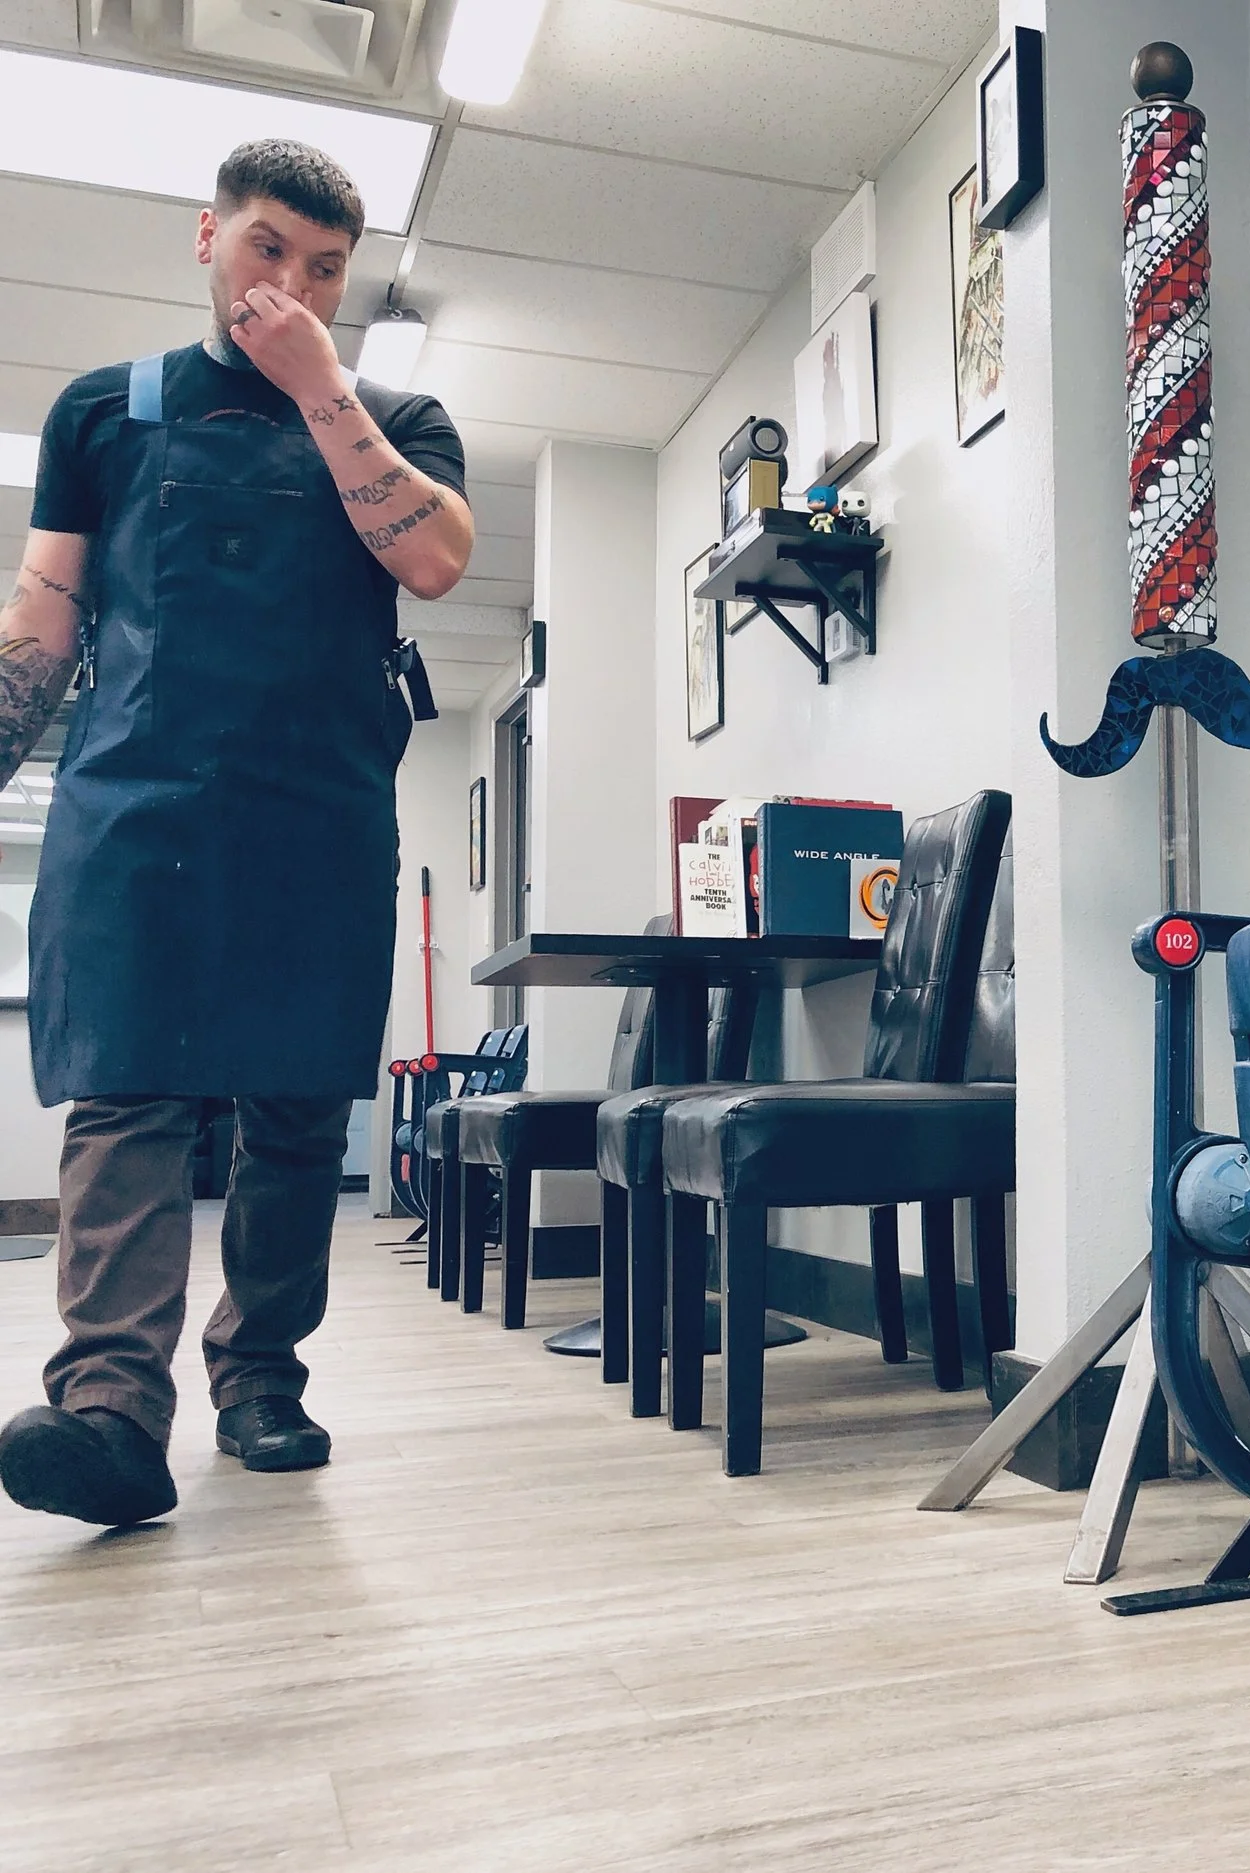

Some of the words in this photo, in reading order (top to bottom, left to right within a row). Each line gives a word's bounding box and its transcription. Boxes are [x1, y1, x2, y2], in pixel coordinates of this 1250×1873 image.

[793, 850, 828, 860] WIDE
[704, 888, 727, 896] TENTH
[690, 894, 732, 903] ANNIVERSA
[706, 902, 727, 910] BOOK
[1165, 932, 1192, 950] 102
